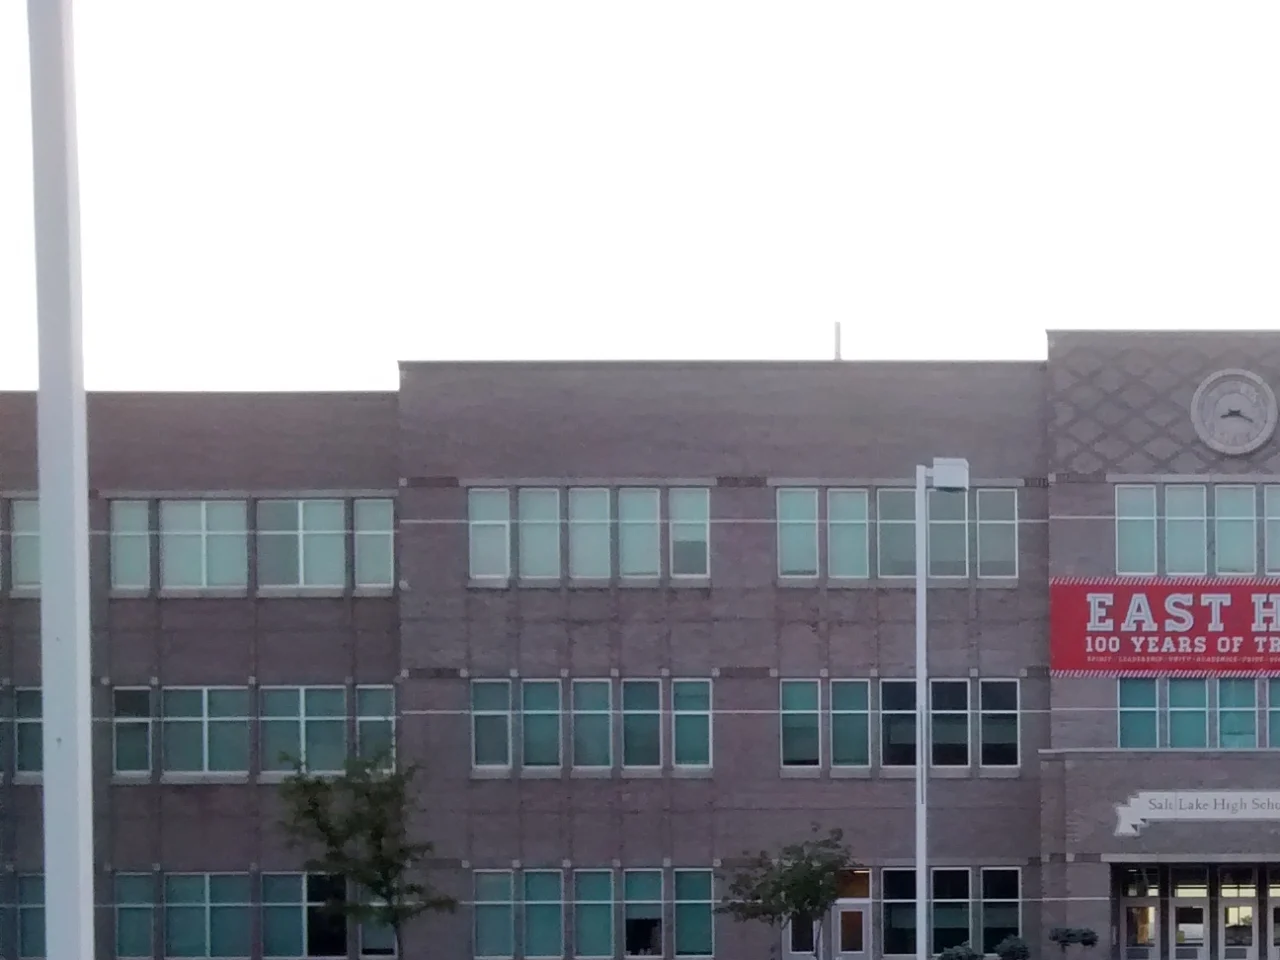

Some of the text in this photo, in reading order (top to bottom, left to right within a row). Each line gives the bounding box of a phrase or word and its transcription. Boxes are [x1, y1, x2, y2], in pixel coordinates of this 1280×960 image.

[1086, 593, 1231, 632] EAST
[1086, 636, 1120, 653] 100
[1131, 636, 1207, 653] YEARS
[1217, 636, 1244, 653] OF
[1148, 798, 1173, 810] Salt
[1178, 798, 1209, 810] Lake
[1213, 798, 1247, 814] High
